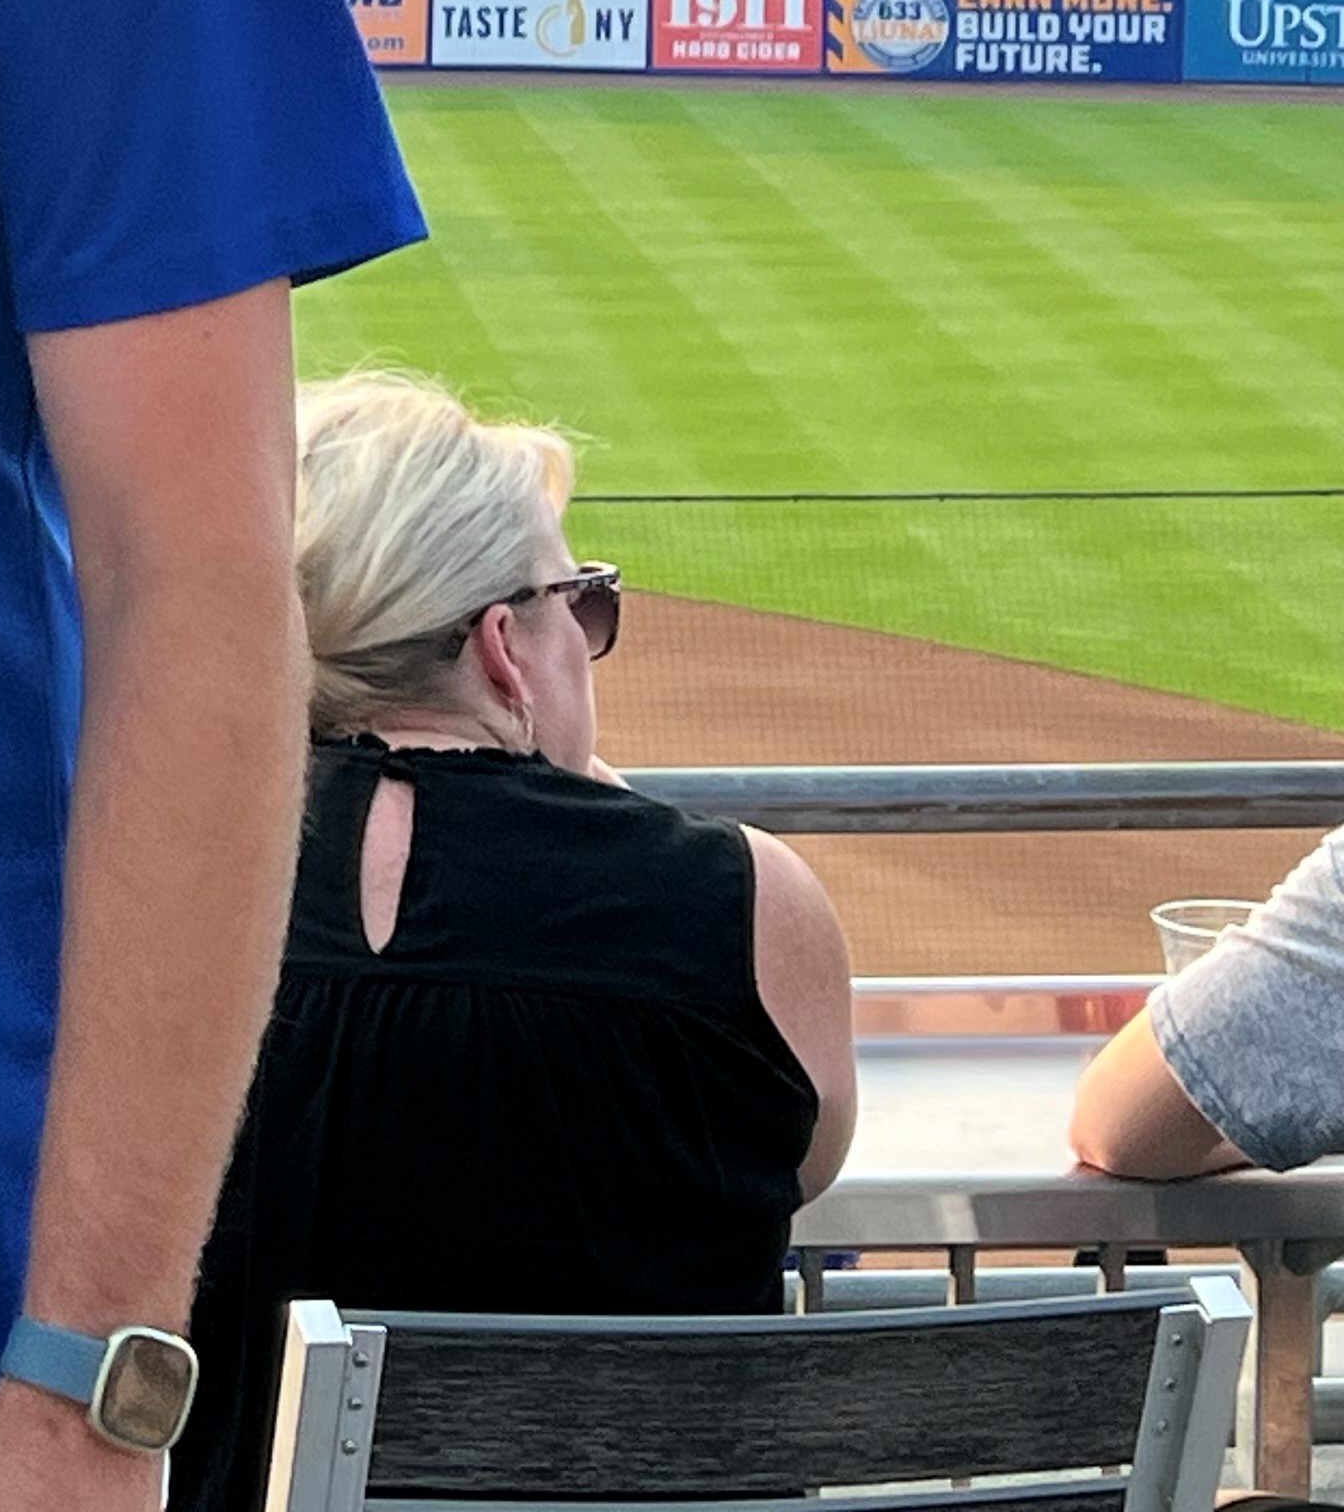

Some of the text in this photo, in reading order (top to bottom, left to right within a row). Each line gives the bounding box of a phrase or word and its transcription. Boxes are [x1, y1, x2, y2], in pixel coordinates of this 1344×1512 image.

[442, 6, 635, 41] TASTE NY
[878, 1, 922, 20] 633
[957, 12, 1166, 44] BUILD YOUR
[672, 41, 801, 61] HARD CIDER
[955, 43, 1102, 74] FUTURE.
